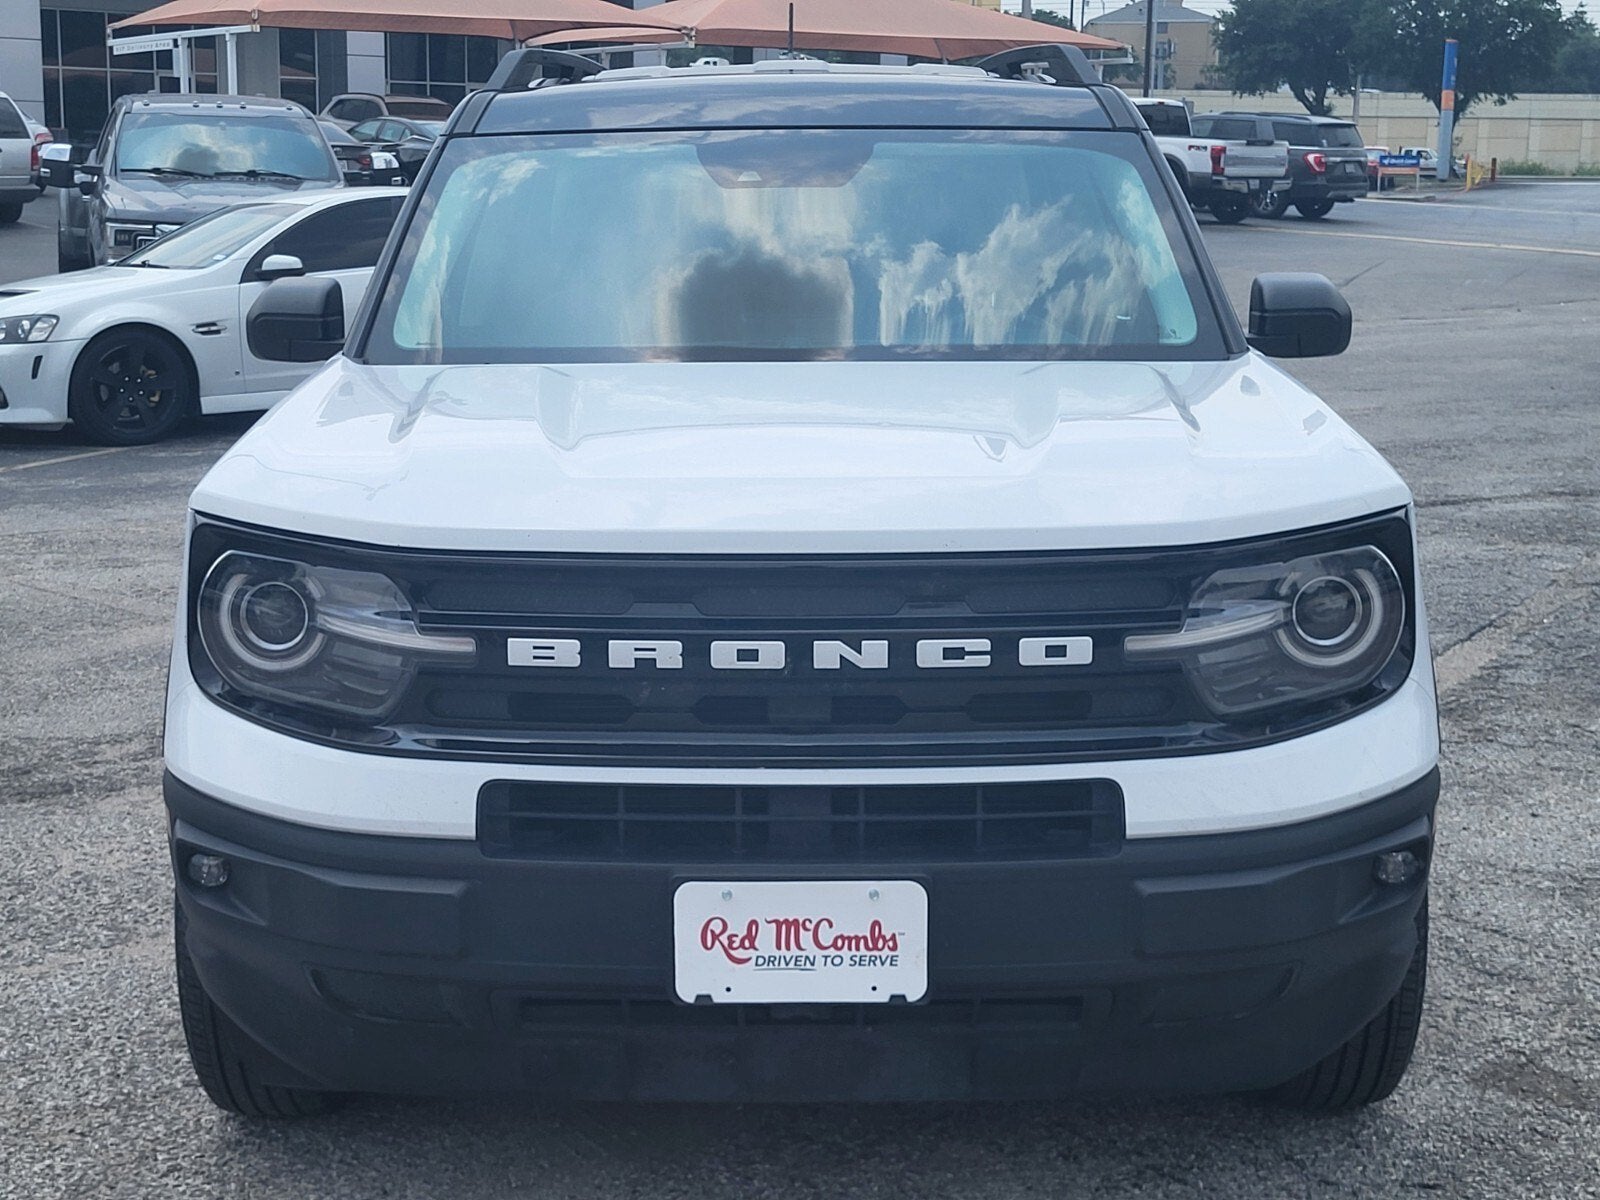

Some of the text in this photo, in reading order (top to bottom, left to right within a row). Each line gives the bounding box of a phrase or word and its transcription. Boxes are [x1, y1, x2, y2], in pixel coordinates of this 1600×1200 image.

[127, 43, 153, 51] Delivery
[507, 636, 1093, 669] BRONCO
[700, 916, 898, 965] Red McCombs
[754, 954, 899, 968] DRIVEN TO SERVE
